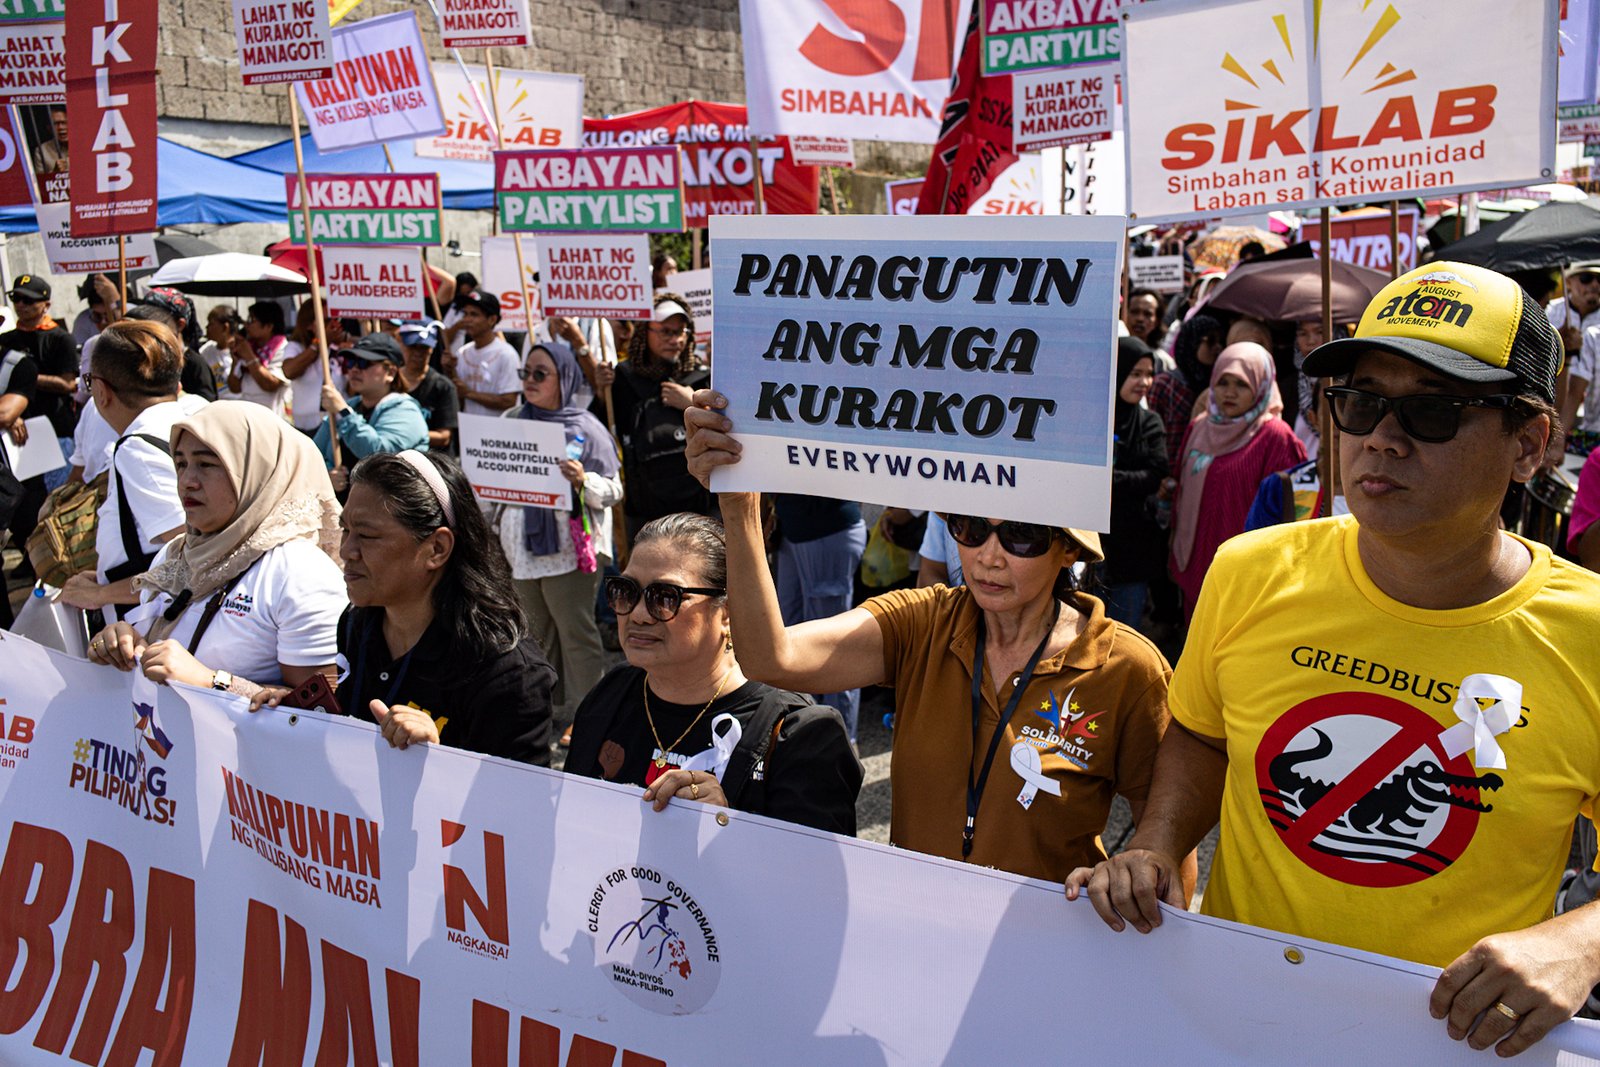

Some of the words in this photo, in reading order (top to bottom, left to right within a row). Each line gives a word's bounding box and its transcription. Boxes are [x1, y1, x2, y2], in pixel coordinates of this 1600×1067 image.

[242, 5, 286, 25] LAHAT
[293, 0, 315, 20] NG
[444, 11, 520, 31] MANAGOT!
[988, 0, 1119, 32] AKBAYA
[0, 52, 65, 69] KURAK
[243, 40, 325, 66] MANAGOT!
[989, 27, 1120, 67] PARTYLIS
[304, 46, 420, 108] KALIPUNAN
[1025, 80, 1072, 100] LAHAT
[1081, 77, 1103, 92] NG
[314, 109, 335, 126] NG
[336, 97, 390, 122] KILUSANG
[392, 91, 427, 112] MASA
[781, 88, 932, 119] SIMBAHAN
[436, 119, 562, 147] SIKAB
[674, 123, 720, 143] ANG
[1020, 110, 1107, 135] MANAGOT!
[1160, 83, 1498, 171] SIKLAB
[502, 154, 675, 189] AKBAYAN
[1167, 168, 1290, 195] Simbahan
[1297, 159, 1321, 180] at
[1331, 139, 1485, 175] Komunidad
[292, 179, 435, 208] AKBAYAN
[1193, 190, 1266, 213] Laban
[1277, 185, 1304, 203] sa
[1315, 169, 1454, 199] Katiwalian
[503, 194, 675, 225] PARTYLIST
[983, 199, 1044, 215] SIK
[293, 212, 436, 239] PARTYLIST
[107, 260, 137, 268] YOTH
[548, 248, 602, 264] LAHAT
[611, 248, 634, 263] NG
[329, 263, 370, 281] JAIL
[379, 264, 415, 282] ALL
[733, 253, 1093, 306] PANAGUTIN
[329, 283, 417, 298] PLUNDERERS!
[547, 283, 644, 301] MANAGOT!
[1421, 286, 1462, 299] AUGUST
[1386, 317, 1440, 328] MOVEMENT
[762, 318, 882, 367] ANG
[889, 324, 1041, 375] MGA
[754, 381, 1056, 442] KURAKOT
[466, 448, 507, 460] HOLDING
[509, 453, 560, 466] OFFICIALS
[481, 438, 538, 451] NORMALIZE
[476, 460, 549, 476] ACCOUNTABLE
[786, 444, 1017, 488] EVERYWOMAN
[480, 488, 520, 500] AKBAYAN
[521, 493, 551, 504] YOUTH
[1290, 646, 1530, 728] GREEDBUSS
[221, 765, 381, 880] KALIPUNAN
[231, 820, 252, 848] NG
[252, 837, 321, 890] KILUSANG
[326, 871, 381, 909] MASA
[588, 884, 606, 932] CLERGY
[605, 869, 628, 887] FOR
[631, 867, 661, 884] GOOD
[667, 881, 719, 962] GOVERNANCE
[447, 930, 509, 959] NAGKAISA!
[613, 965, 663, 985] MAKA-DIYOS
[613, 974, 674, 997] MAKA-FILIPINO
